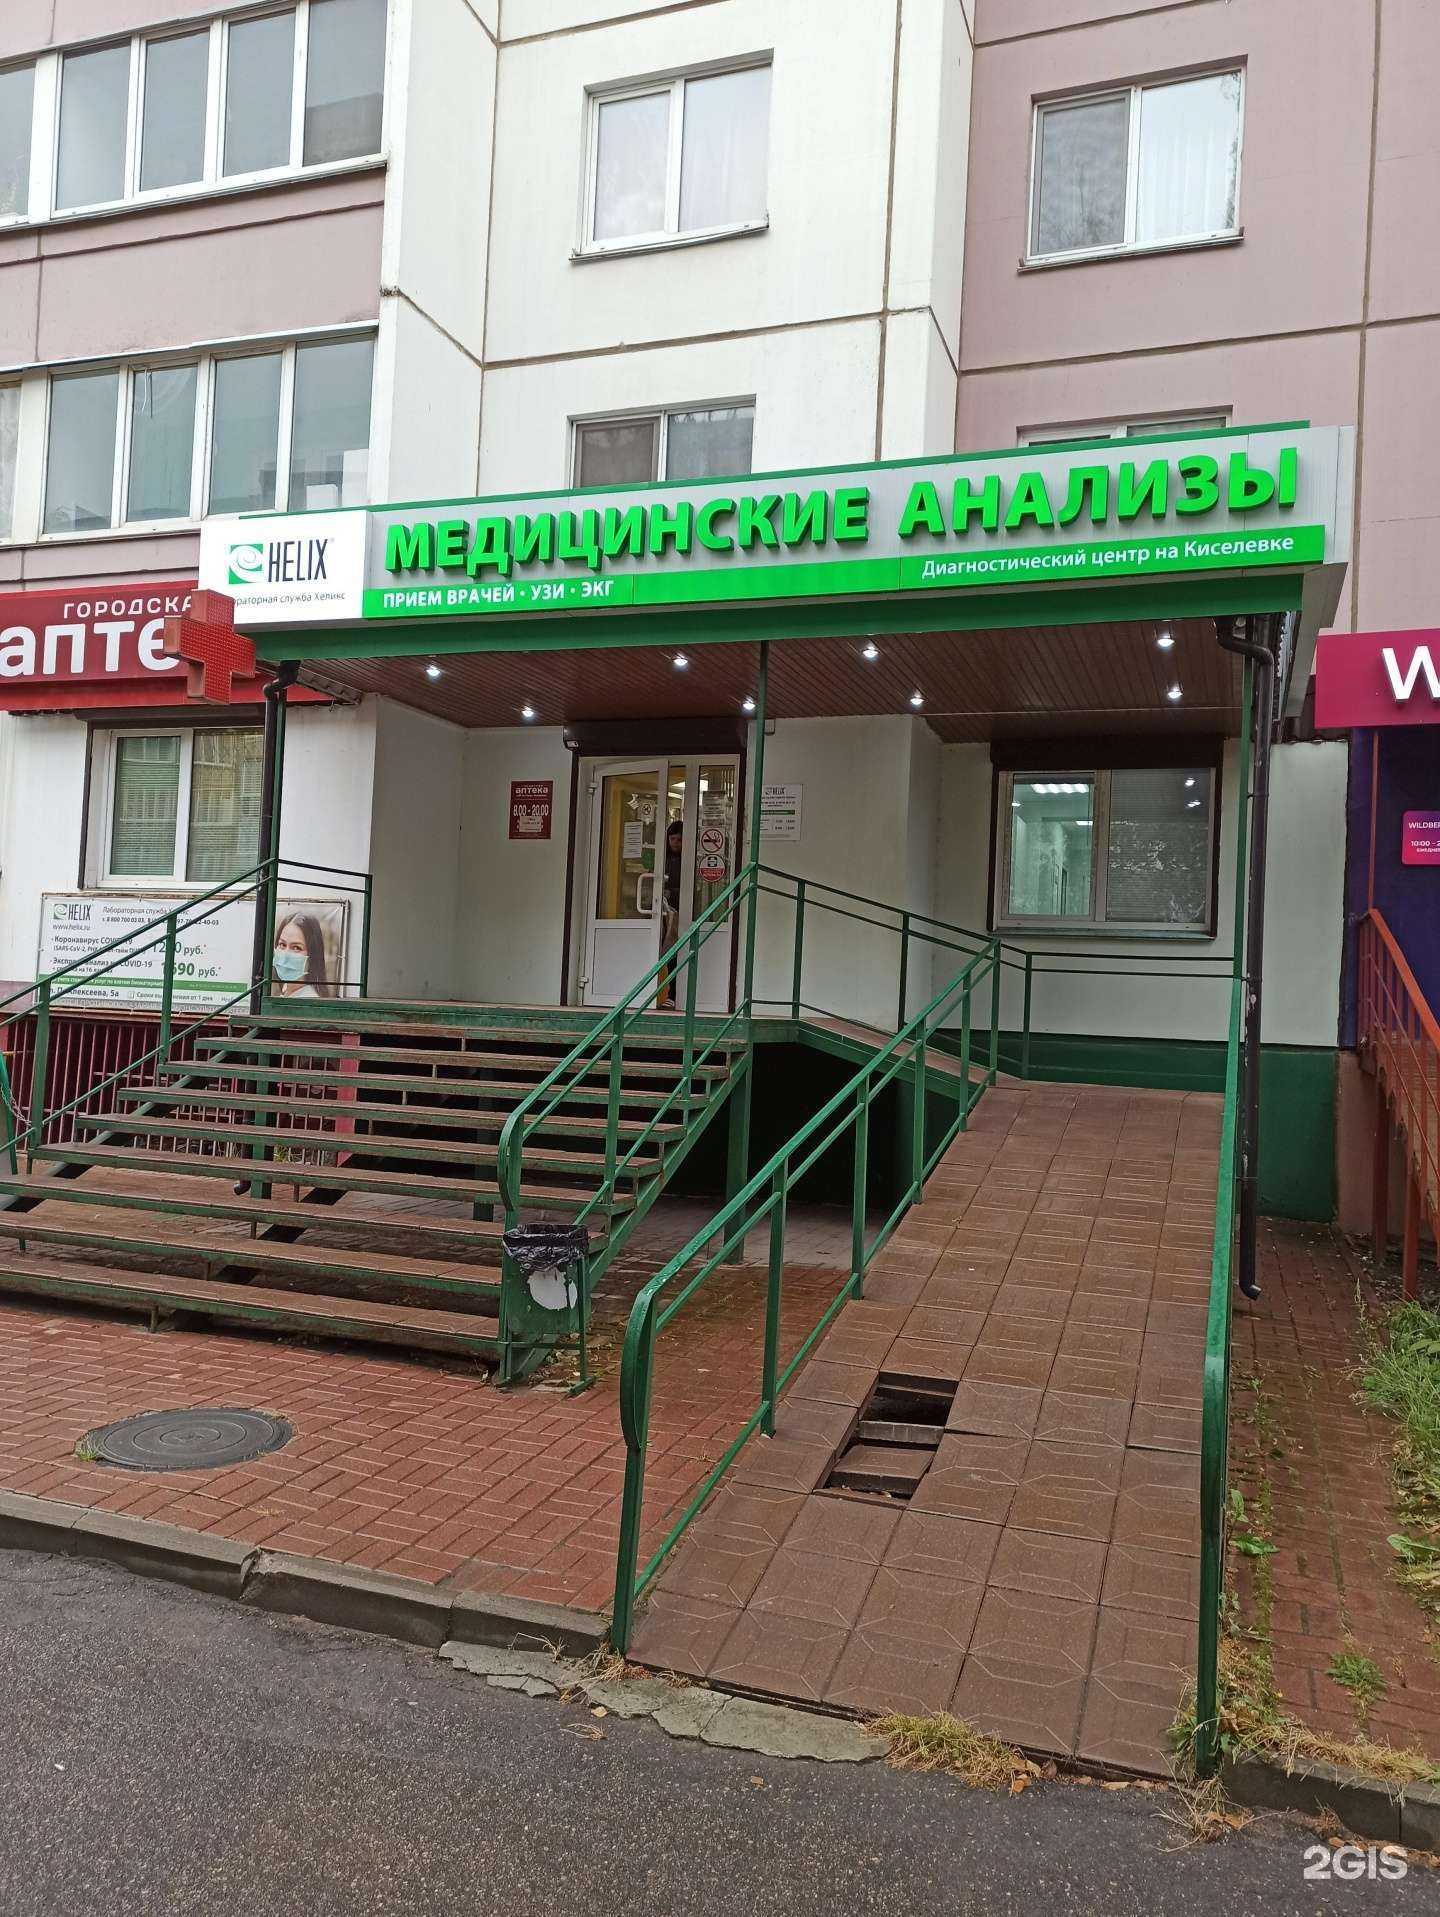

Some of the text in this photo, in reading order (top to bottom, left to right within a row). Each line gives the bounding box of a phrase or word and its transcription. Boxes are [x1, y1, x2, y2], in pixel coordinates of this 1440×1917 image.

[385, 447, 1298, 577] МЕДИЦИНСКИЕ АНАЛИЗЫ
[268, 539, 328, 582] HELIX
[922, 536, 1295, 579] Диагностический центр на Киселевке
[235, 590, 346, 607] раторная служба Хеликс
[383, 580, 614, 608] ПРИЕМ ВРАЧЕЙ УЗИ ЭКГ
[68, 904, 92, 920] HELIX
[54, 935, 99, 945] Коронавирус
[153, 941, 182, 953] 120
